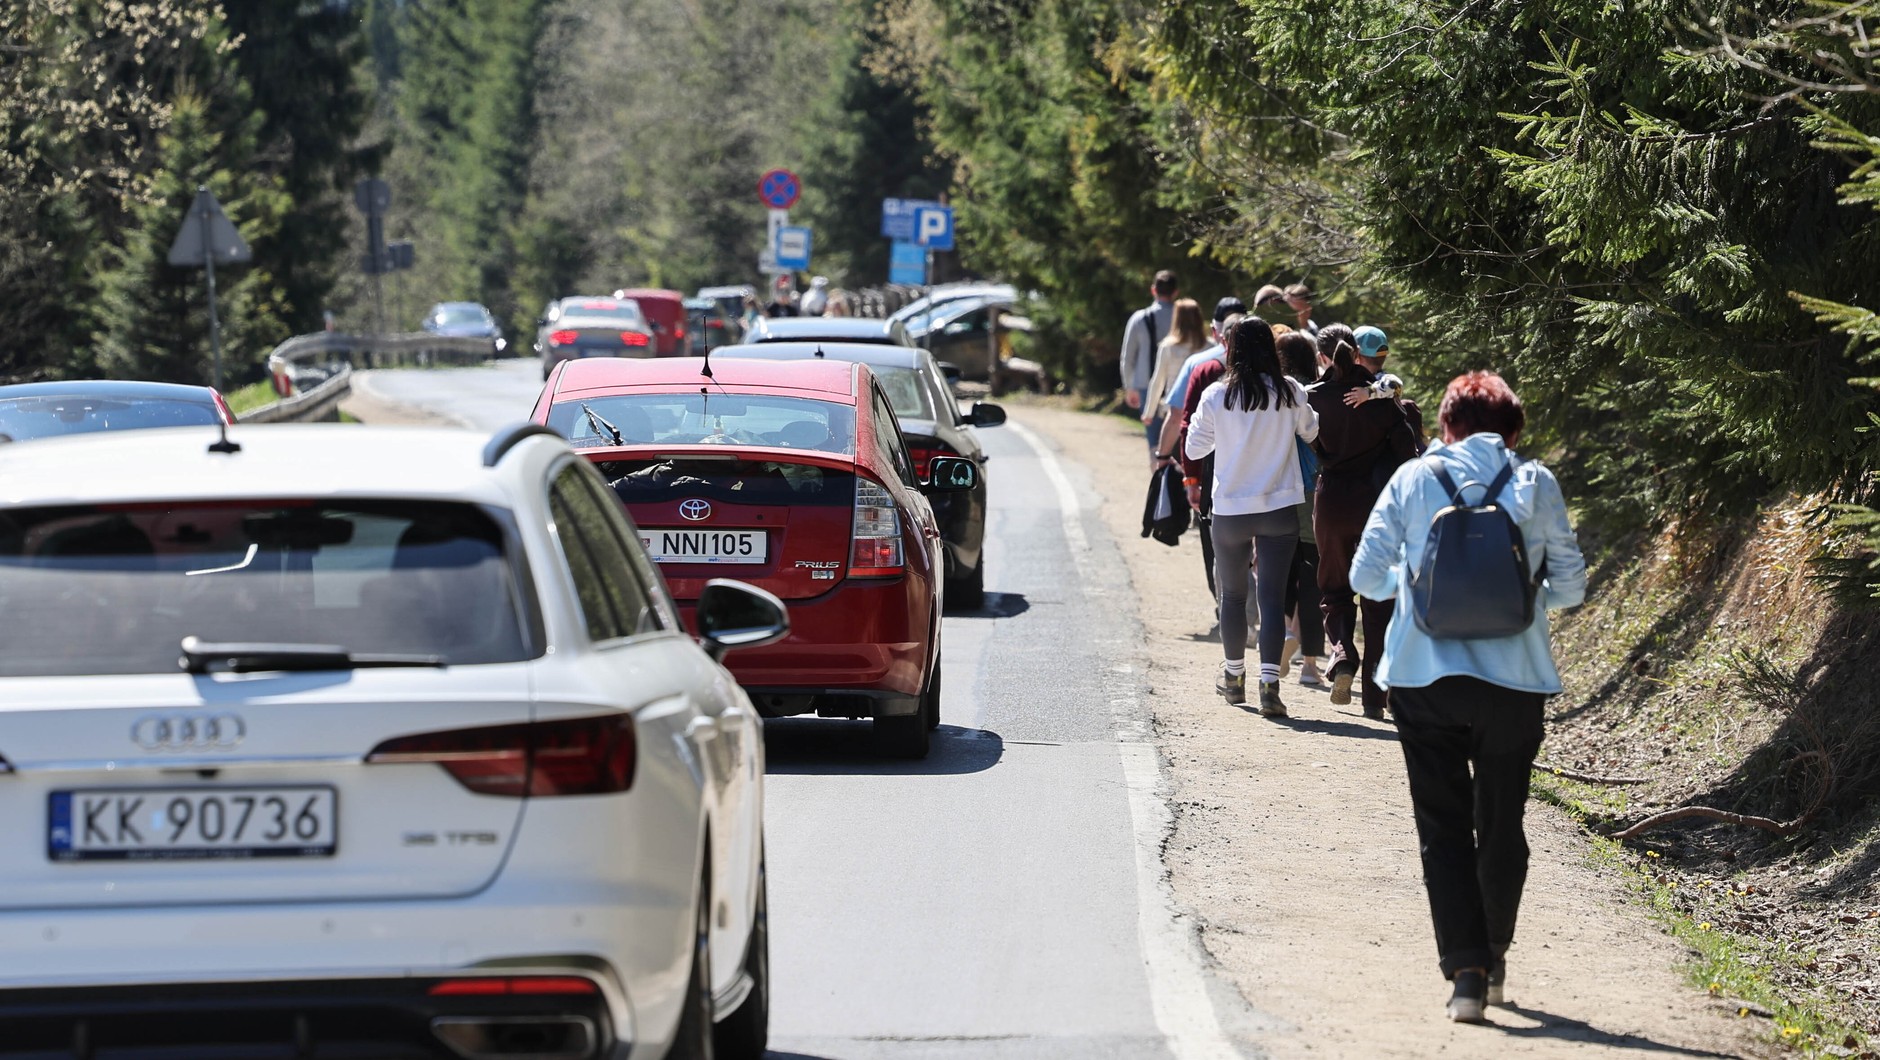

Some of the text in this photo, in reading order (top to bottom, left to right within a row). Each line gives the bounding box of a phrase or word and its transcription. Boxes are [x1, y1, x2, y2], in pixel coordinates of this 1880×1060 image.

[920, 210, 946, 244] P
[663, 533, 752, 554] NNI105
[83, 796, 319, 843] KK 90736
